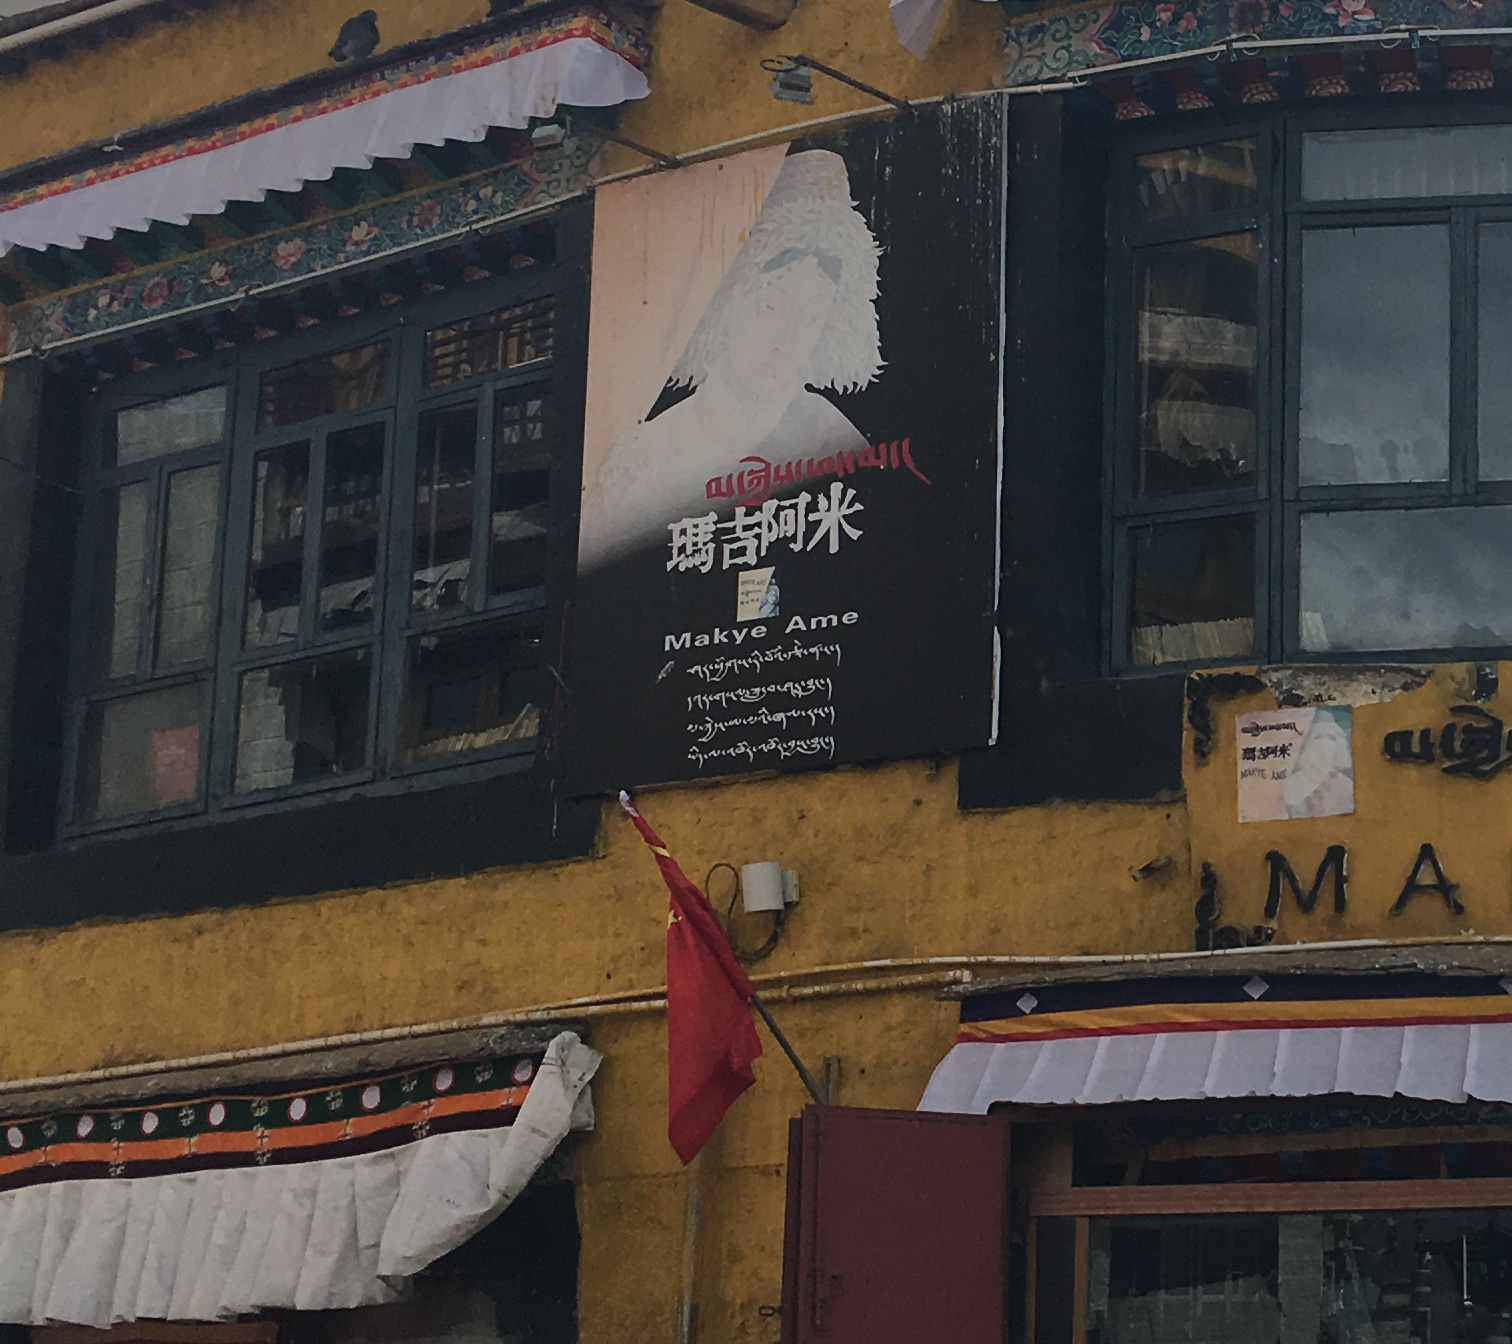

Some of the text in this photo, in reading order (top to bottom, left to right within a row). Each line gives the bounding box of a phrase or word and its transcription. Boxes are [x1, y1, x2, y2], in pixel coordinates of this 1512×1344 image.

[667, 482, 864, 573] 瑪吉阿米
[664, 611, 859, 651] Makye Ame
